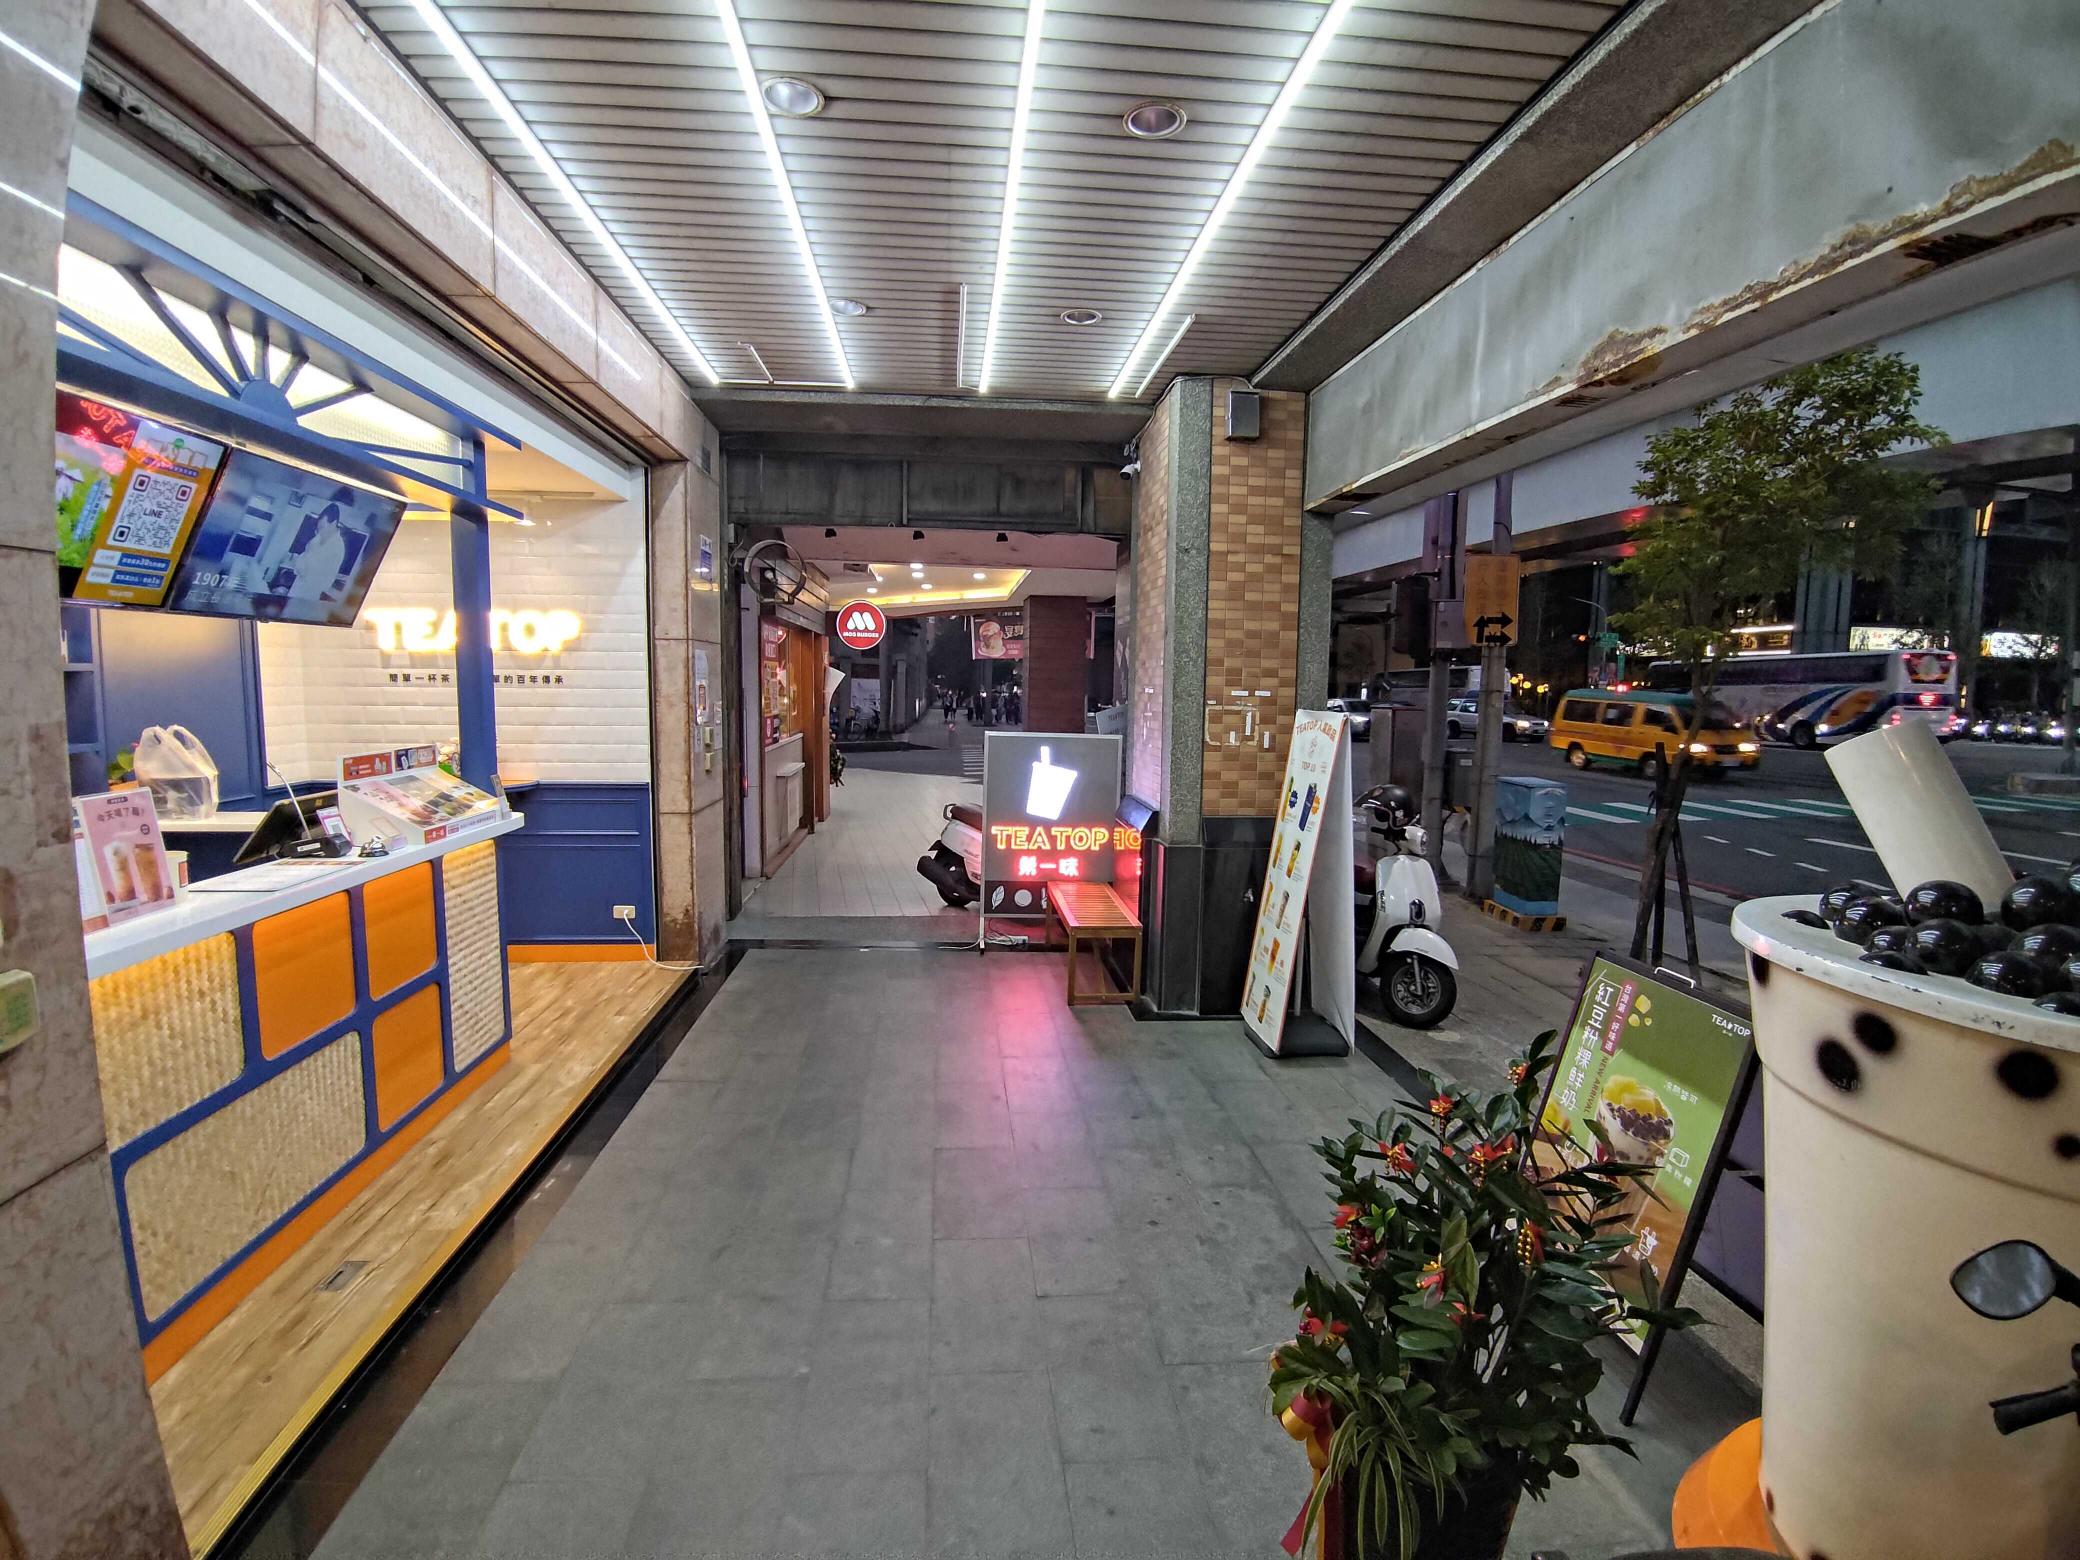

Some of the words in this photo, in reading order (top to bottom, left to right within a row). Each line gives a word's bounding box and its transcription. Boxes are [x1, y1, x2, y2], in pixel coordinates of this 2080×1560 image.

[143, 507, 164, 519] LINE
[389, 673, 451, 684] 簡單一杯茶
[1560, 982, 1615, 1112] 紅豆粉粿鮮奶
[1597, 1056, 1609, 1076] NEW
[1584, 1079, 1601, 1113] ARRIVAL
